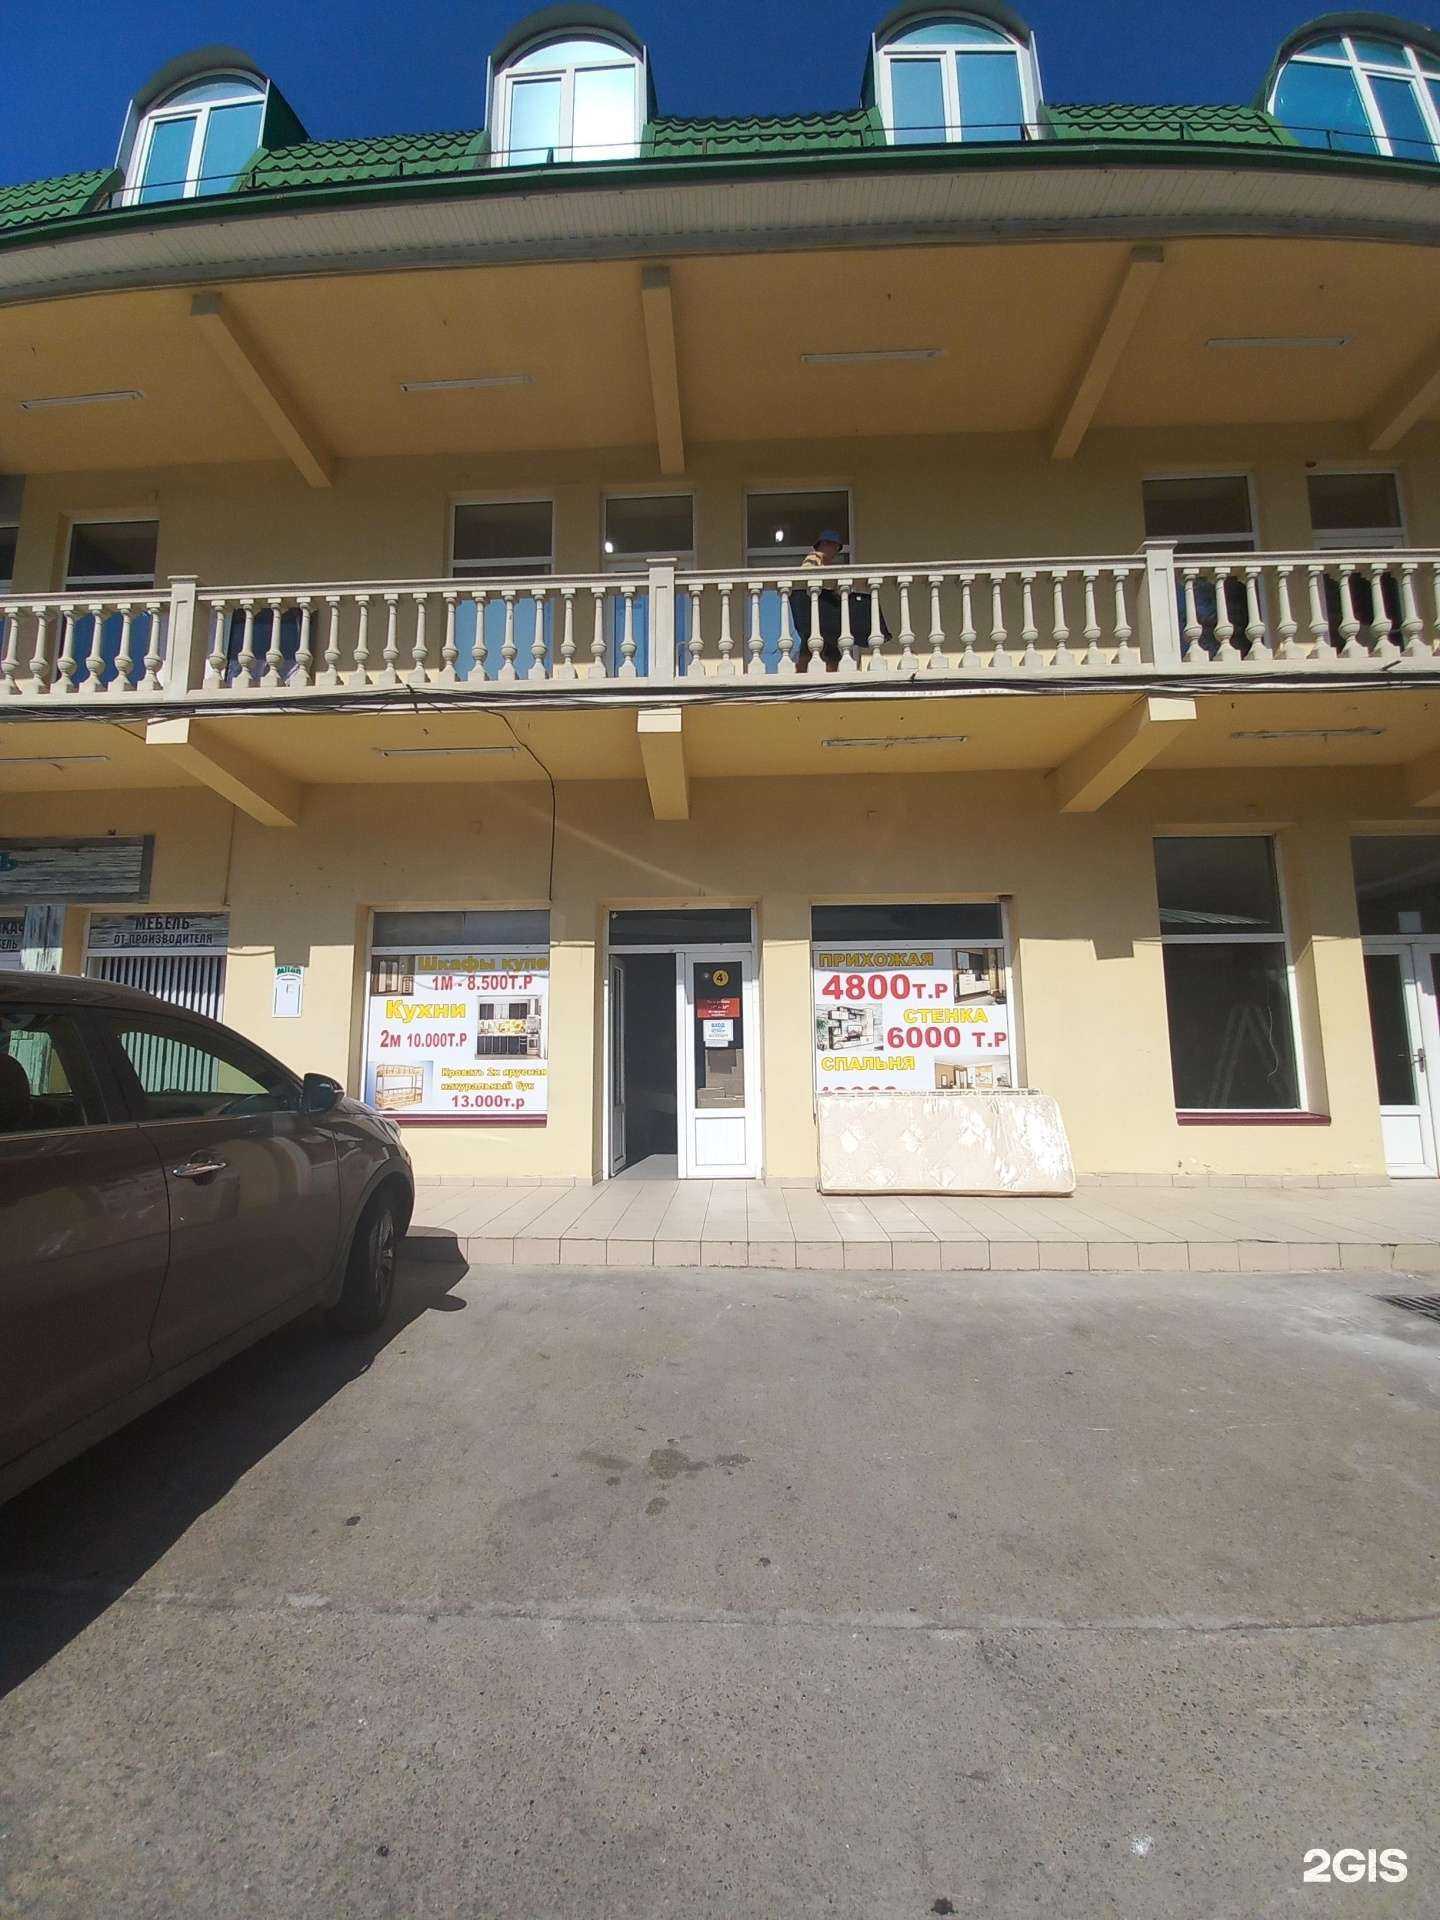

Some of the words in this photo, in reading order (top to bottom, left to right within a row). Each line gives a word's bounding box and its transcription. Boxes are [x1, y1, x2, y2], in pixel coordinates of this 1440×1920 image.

[135, 916, 190, 931] МЕБЕЛЬ
[113, 934, 125, 945] ОТ
[129, 933, 213, 945] ПРОИЗВОДИТЕЛЯ
[417, 956, 496, 973] Шкафы
[819, 952, 934, 968] ПРИХОЖАЯ
[385, 999, 467, 1023] Кухни
[903, 1007, 989, 1023] СТЕНКА
[887, 1026, 961, 1049] 6000
[821, 1056, 915, 1071] СПАЛЬНЯ
